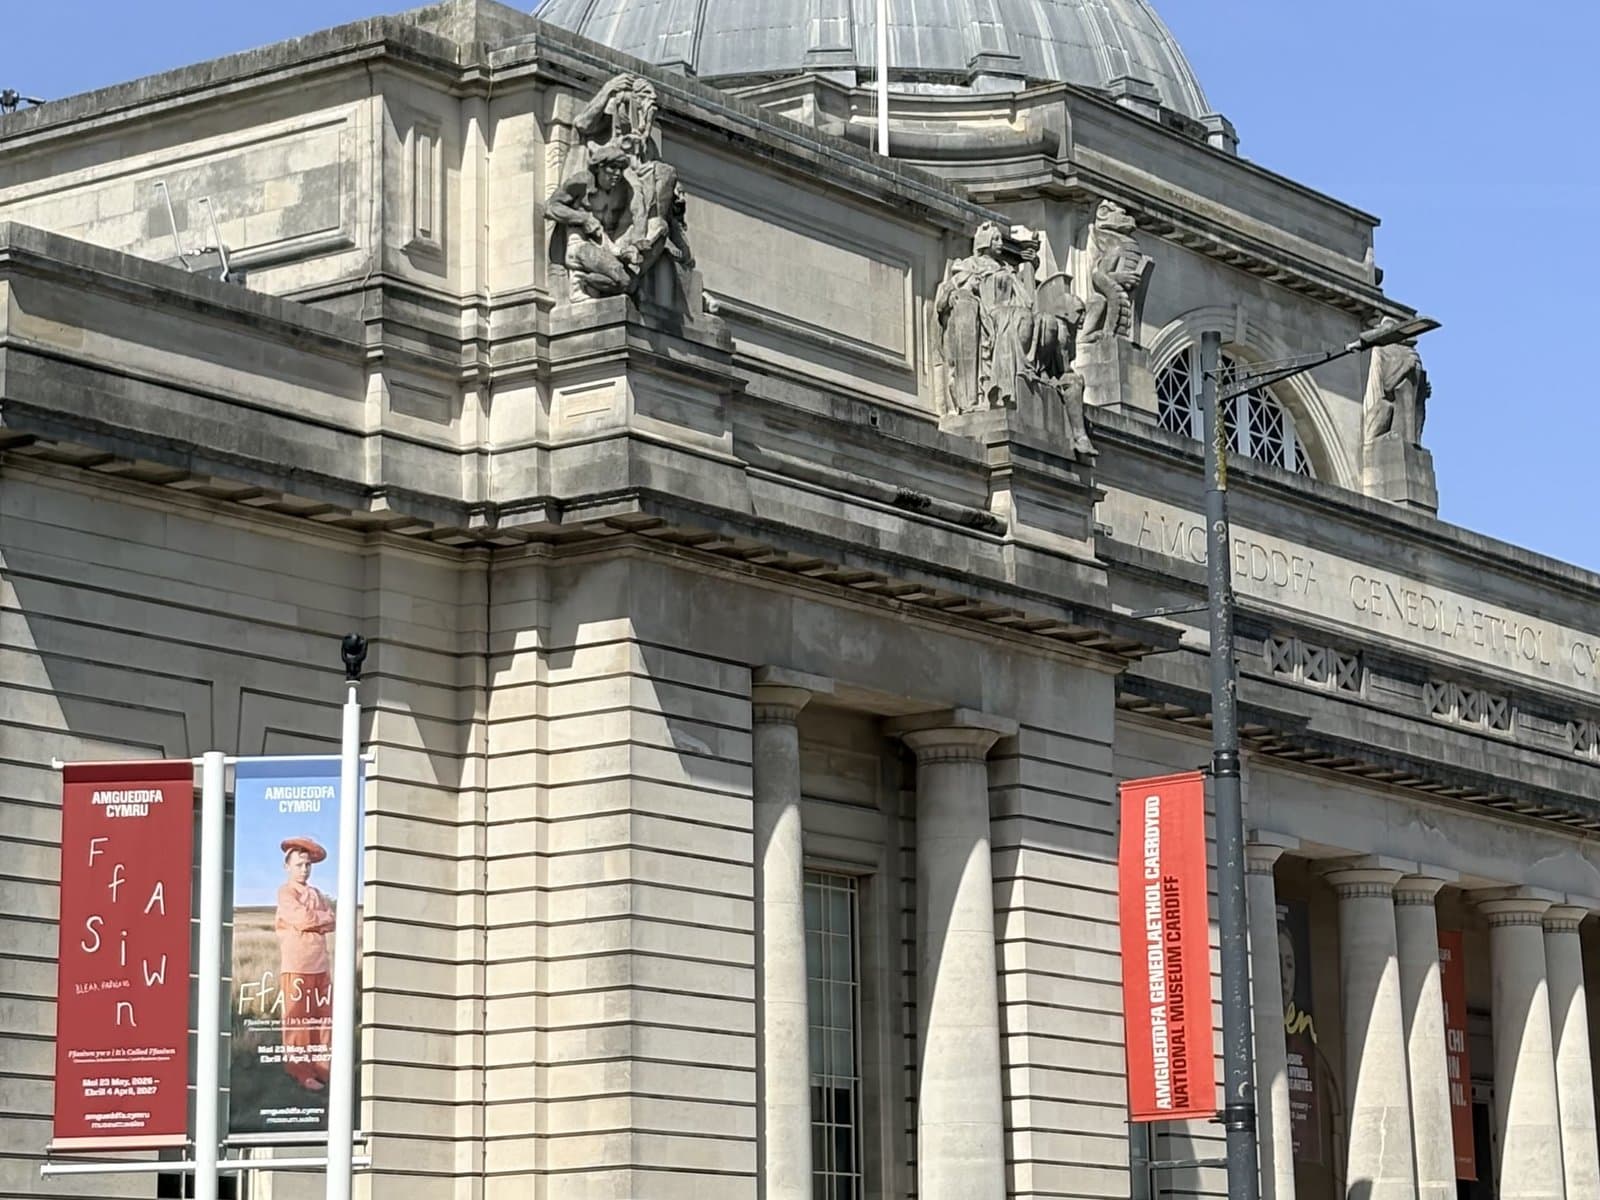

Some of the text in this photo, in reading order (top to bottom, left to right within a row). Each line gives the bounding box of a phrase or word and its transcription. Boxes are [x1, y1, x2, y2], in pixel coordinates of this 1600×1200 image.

[1138, 511, 1321, 596] AMGEDDFA
[1350, 575, 1550, 666] GENEDLAETHOL
[91, 789, 164, 805] AMGUEDDFA
[264, 786, 335, 800] AMGUEDDFA
[105, 803, 149, 818] CYMRU
[278, 799, 321, 814] CYMRU
[1144, 795, 1172, 1110] AMGUEDDFA GENEDLAETHOL CAERDYDD
[1164, 875, 1190, 1109] NATIONAL MUSEUM CARDIFF
